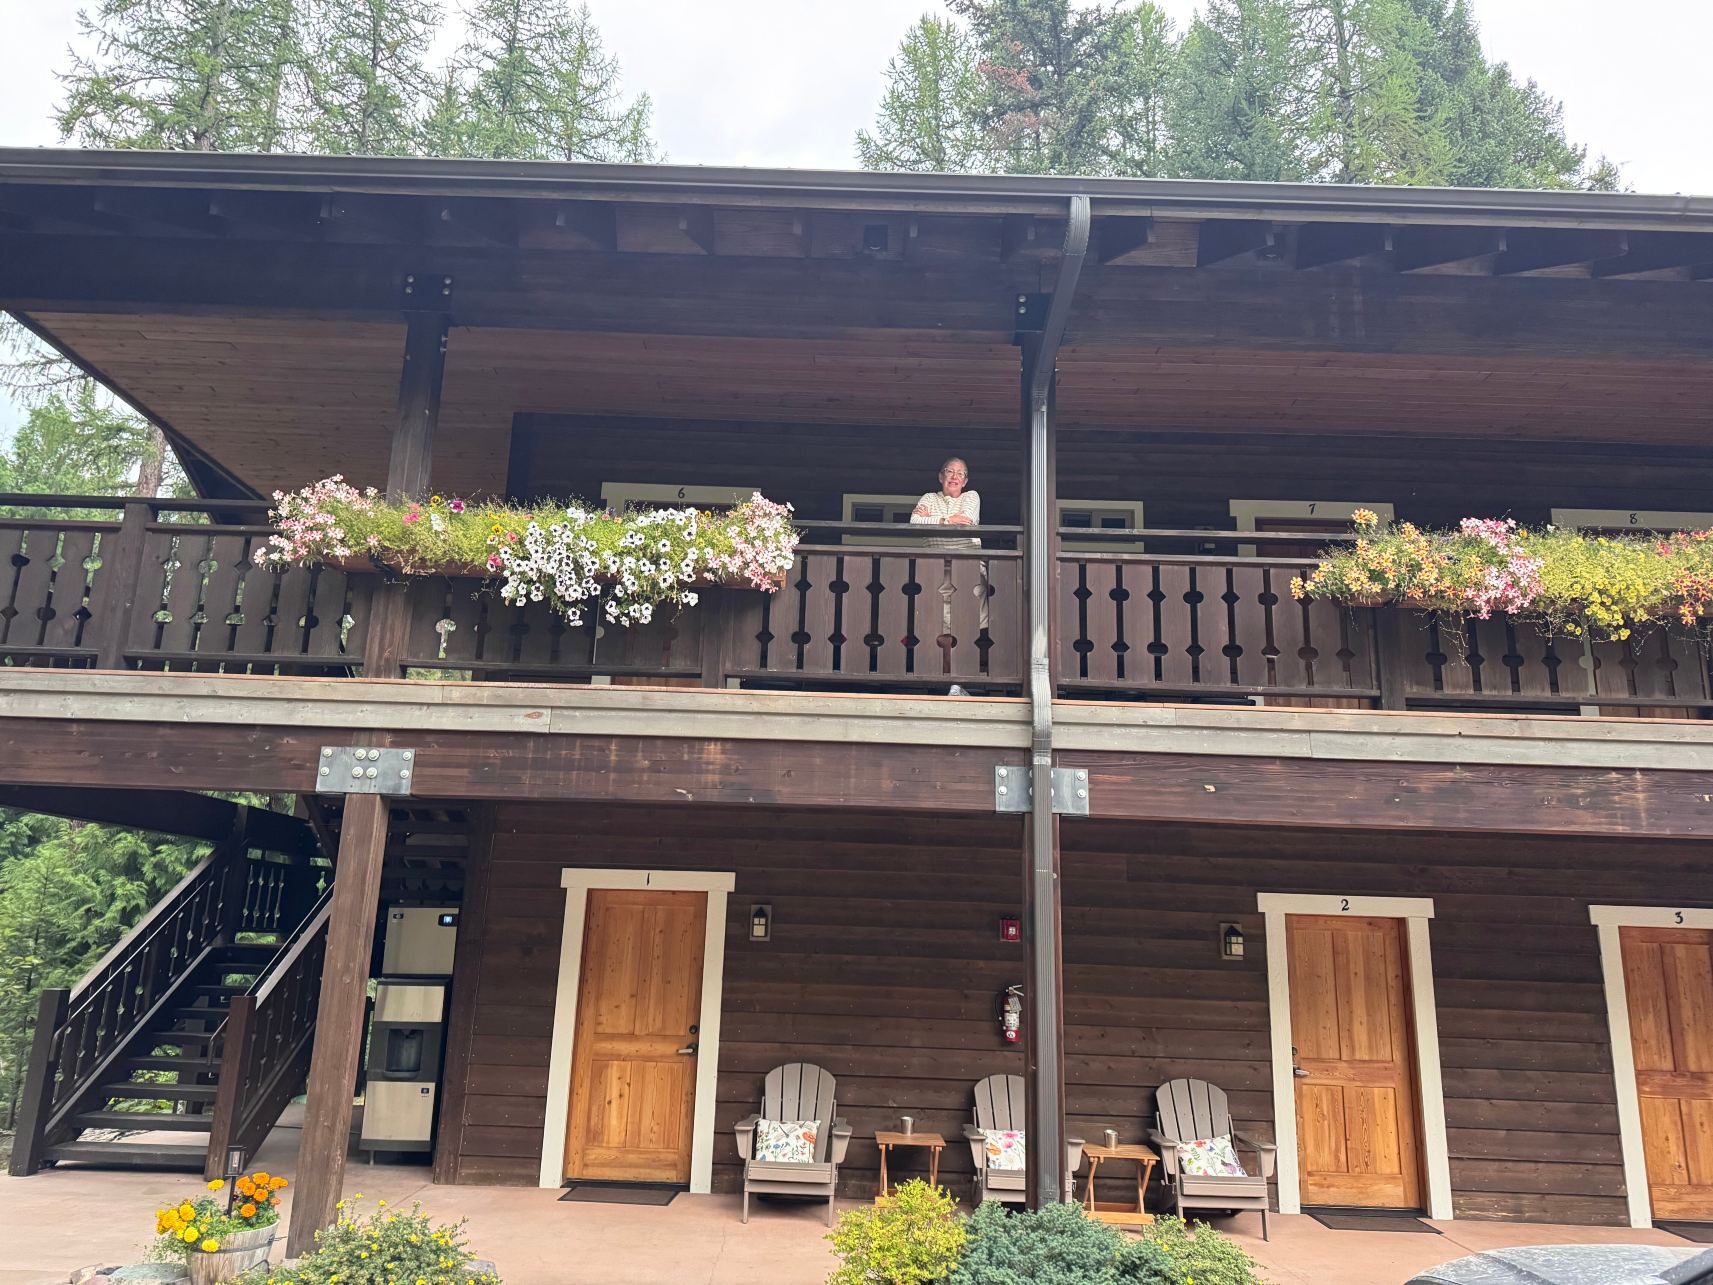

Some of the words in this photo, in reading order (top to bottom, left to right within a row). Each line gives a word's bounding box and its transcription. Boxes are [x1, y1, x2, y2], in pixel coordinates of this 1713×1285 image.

[677, 487, 686, 499] 6
[1308, 503, 1316, 515] 7
[1629, 512, 1638, 525] 8
[1340, 898, 1349, 911] 2
[1674, 911, 1684, 924] 3
